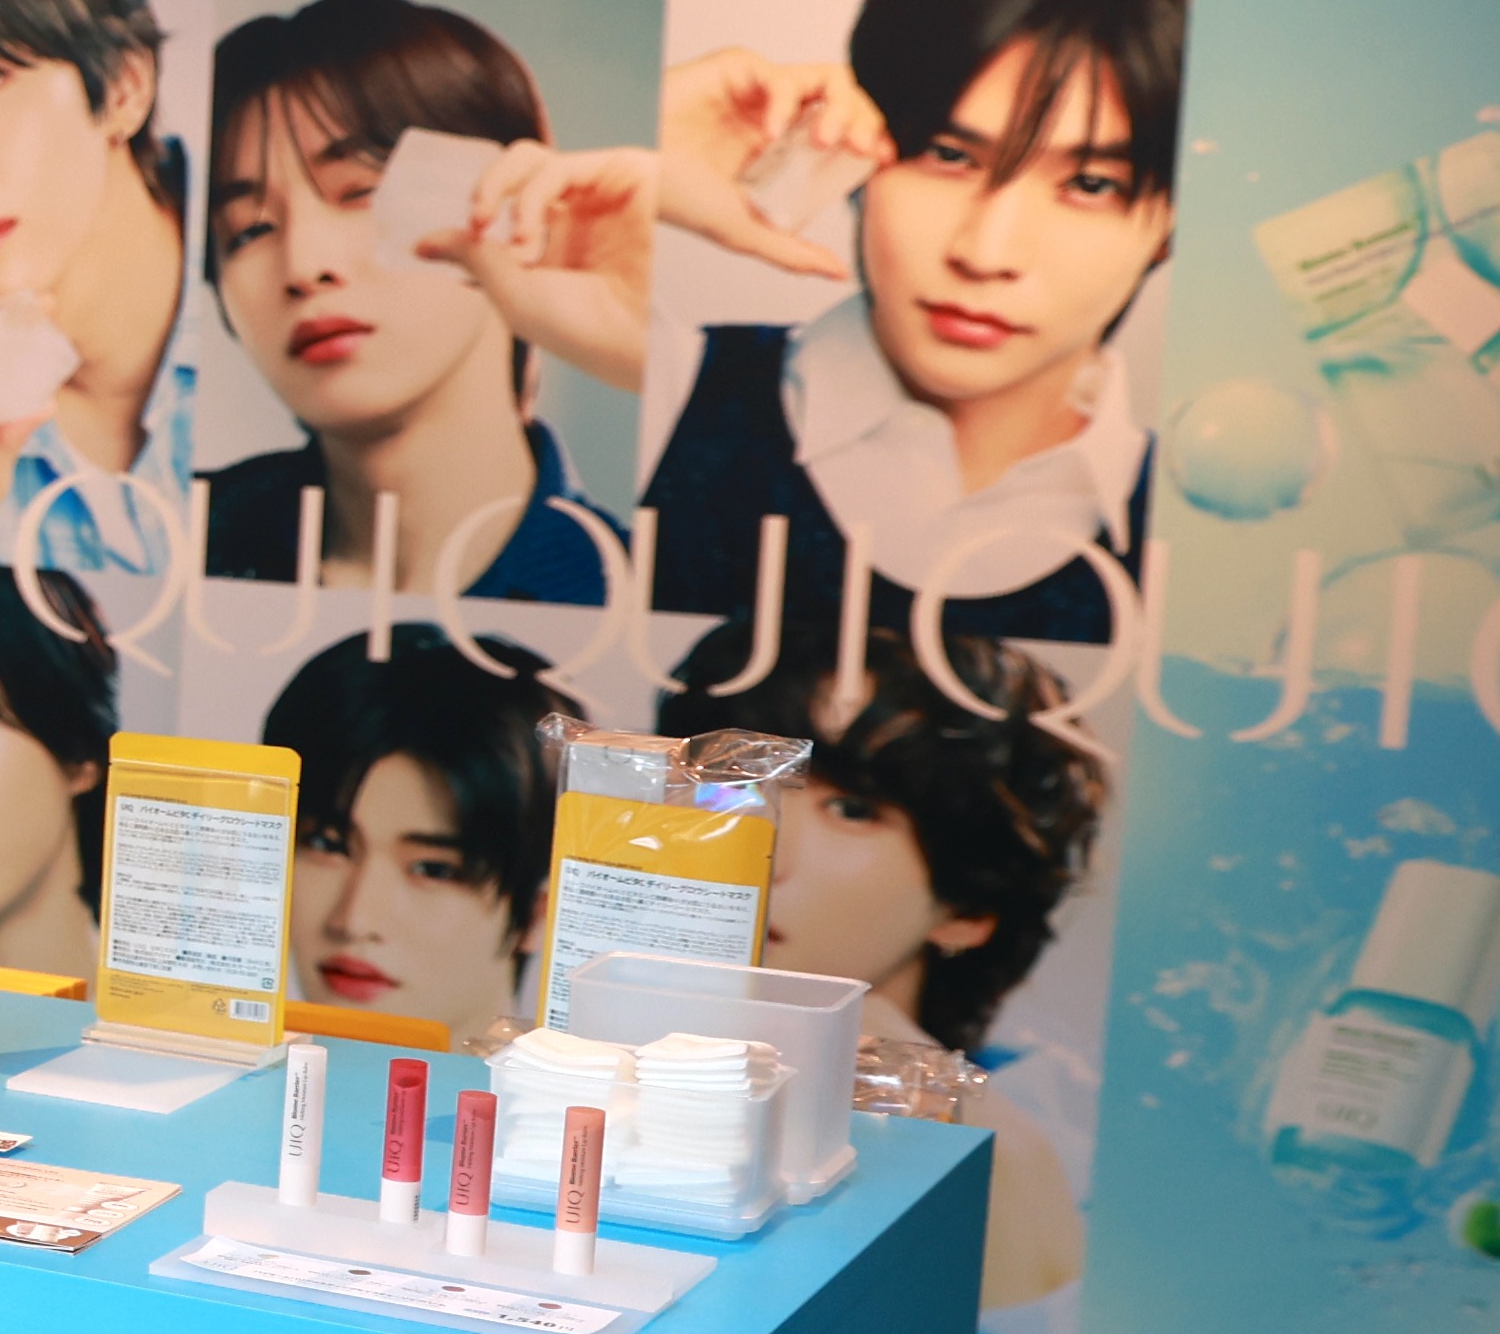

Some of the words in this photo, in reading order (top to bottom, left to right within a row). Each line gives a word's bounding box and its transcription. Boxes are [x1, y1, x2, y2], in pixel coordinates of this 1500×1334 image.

[187, 477, 632, 715] UIQ
[630, 505, 1141, 761] UIQ
[1136, 538, 1500, 751] UI
[288, 1123, 306, 1157] UIQ
[386, 1140, 402, 1173] UIQ
[453, 1171, 472, 1206] UIQ
[565, 1189, 585, 1225] UIQ
